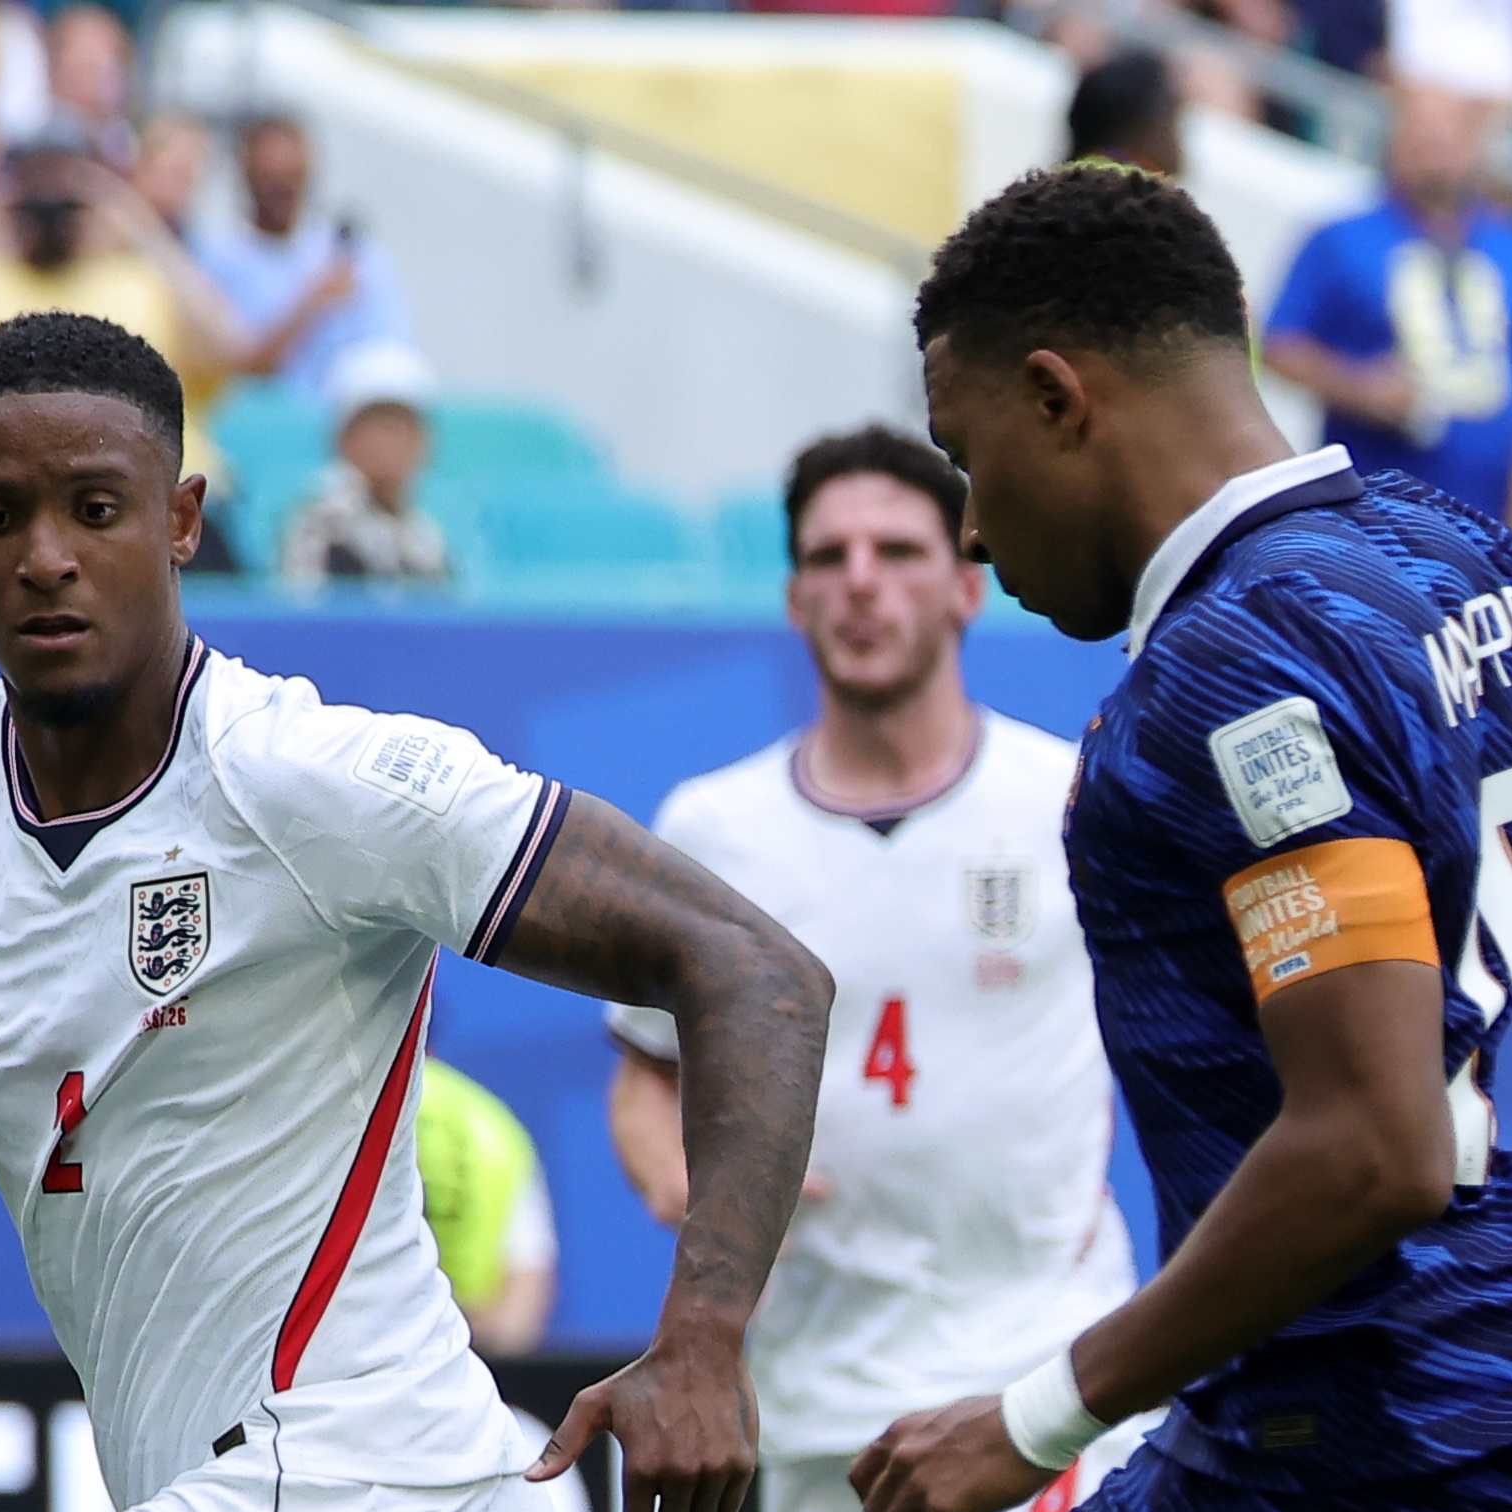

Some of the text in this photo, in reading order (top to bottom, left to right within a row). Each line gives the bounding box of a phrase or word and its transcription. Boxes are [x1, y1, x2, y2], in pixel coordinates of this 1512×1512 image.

[388, 733, 430, 783] UNITES
[1240, 738, 1312, 786] UNITES
[864, 1000, 915, 1105] 4
